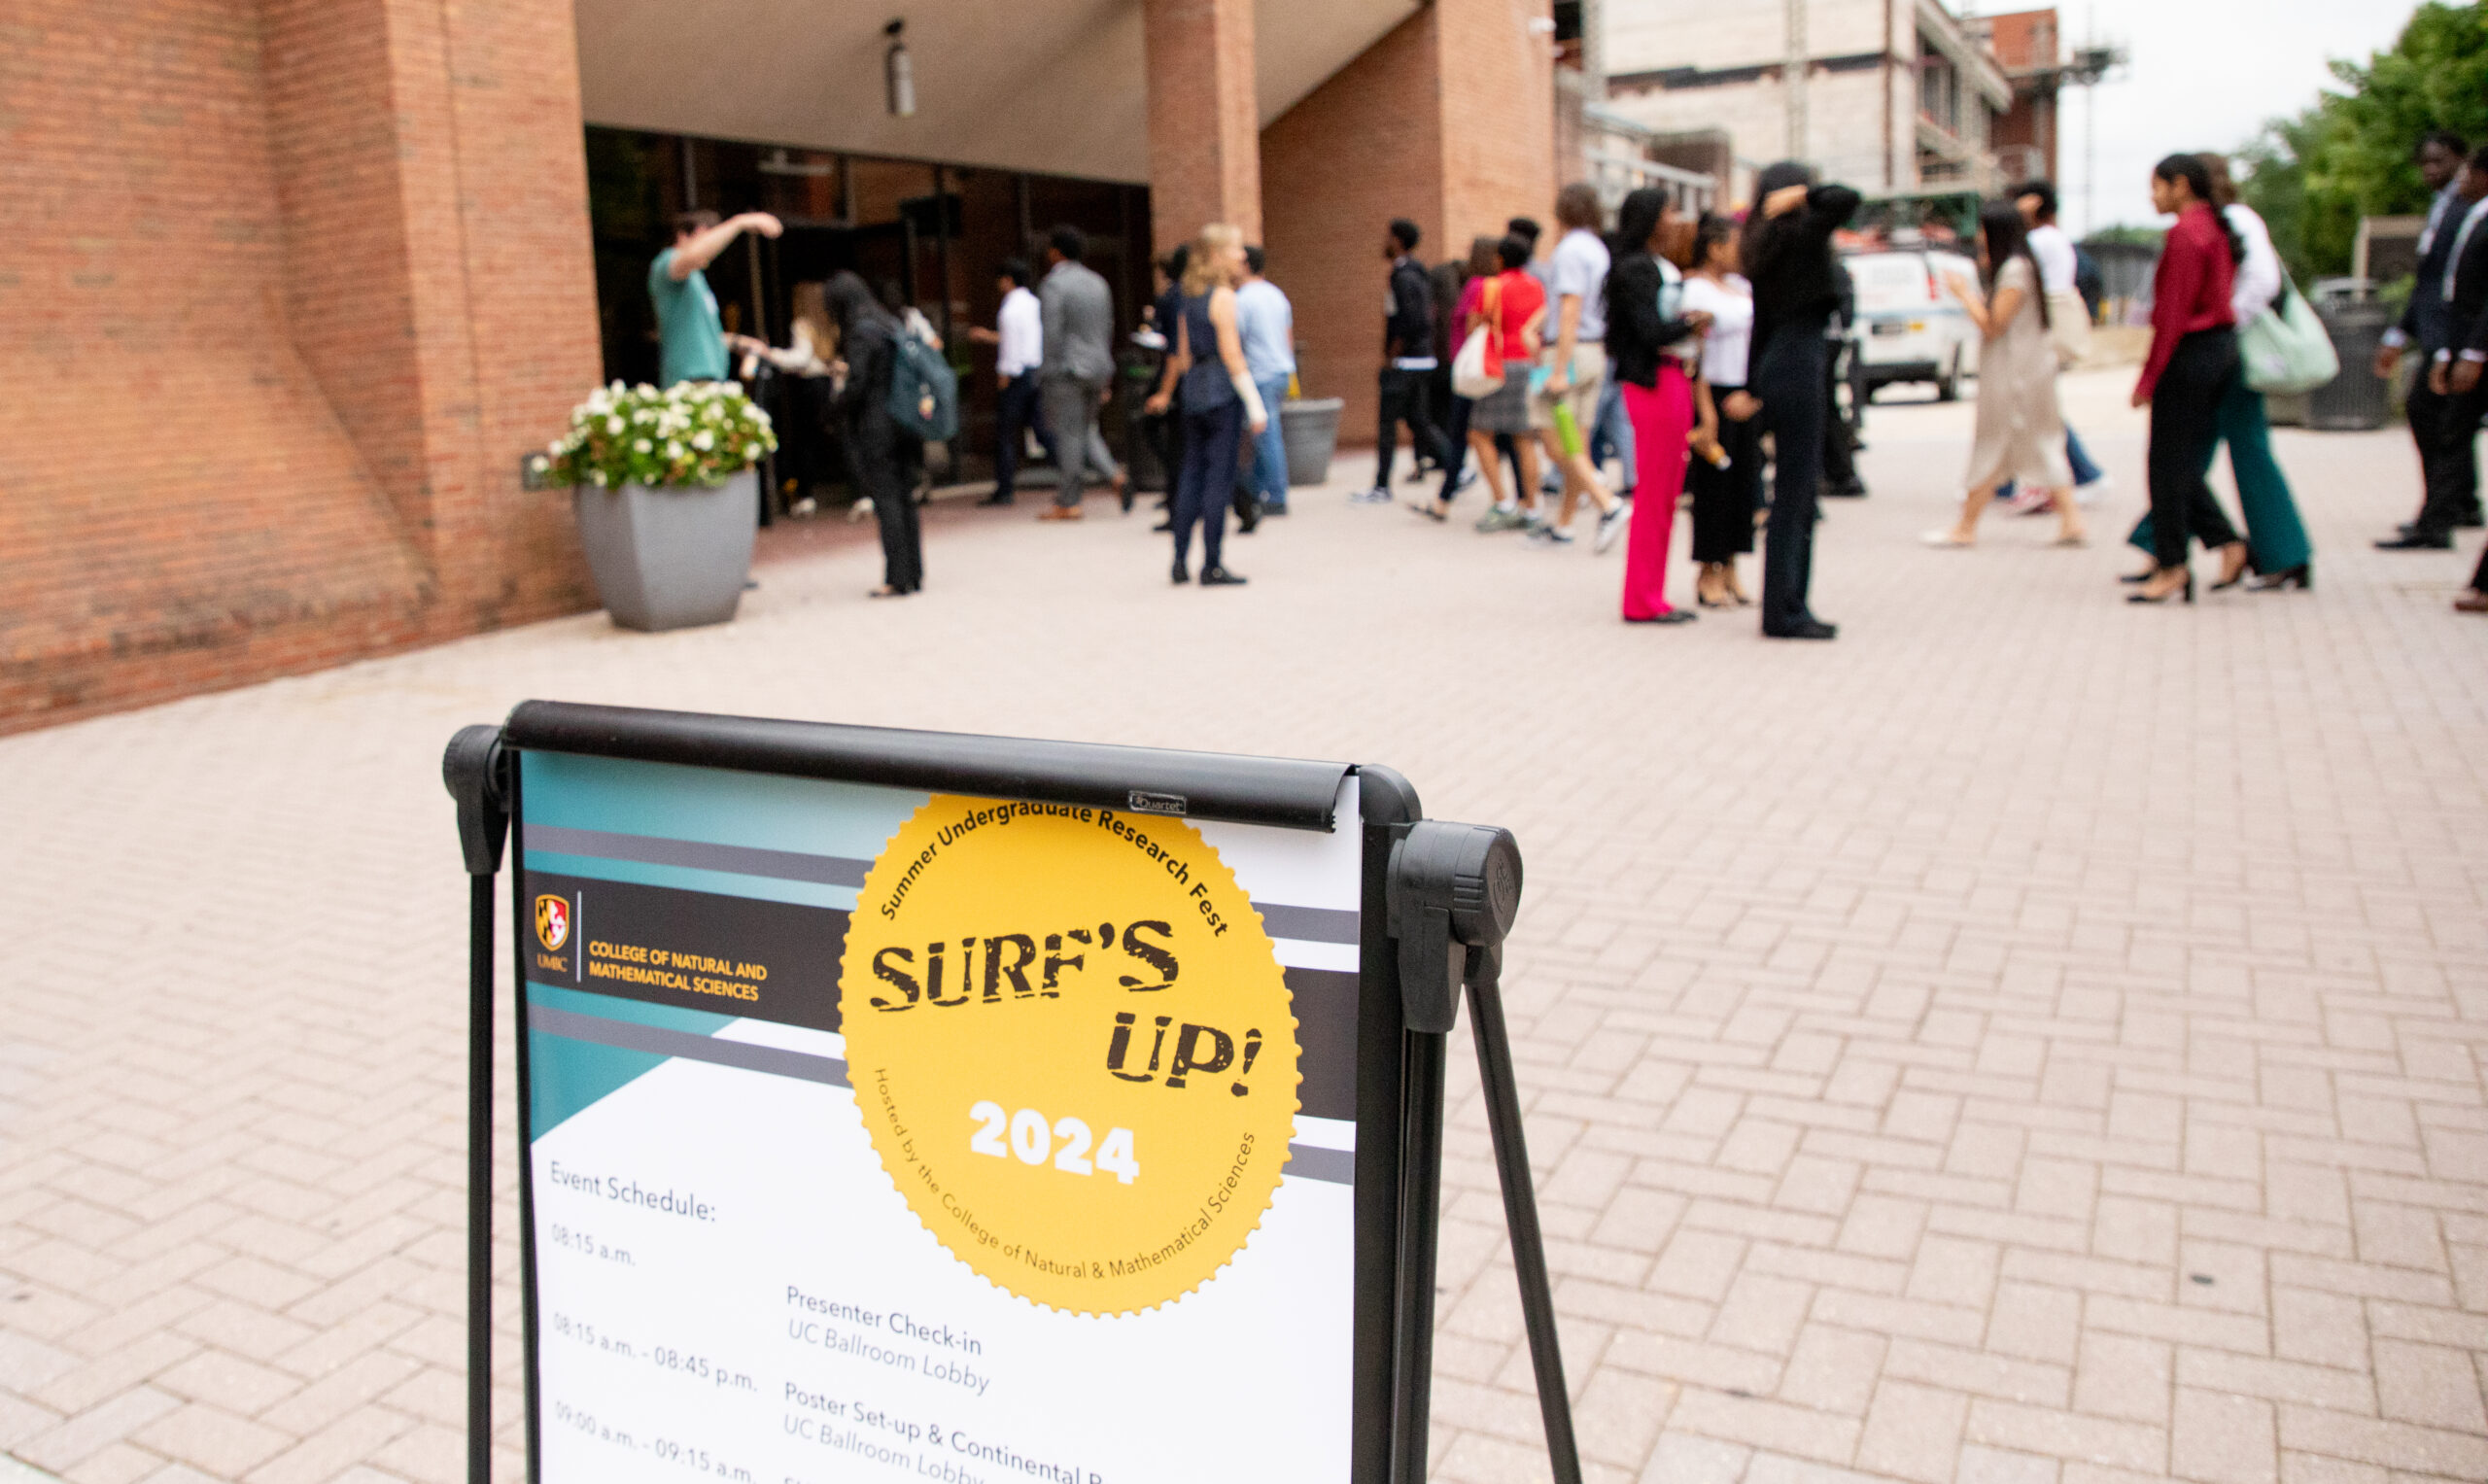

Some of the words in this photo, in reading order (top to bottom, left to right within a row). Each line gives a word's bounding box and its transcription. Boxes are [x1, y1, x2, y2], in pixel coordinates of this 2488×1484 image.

[881, 844, 939, 920] Summer
[936, 802, 1093, 847] Undergraduate
[1097, 810, 1192, 885] Research
[1189, 881, 1229, 938] Fest
[536, 953, 569, 973] UMBC
[589, 940, 648, 963] COLLEGE
[649, 948, 671, 967] OF
[672, 951, 734, 977] NATURAL
[732, 962, 768, 981] AND
[589, 960, 692, 991] MATHEMATICAL
[693, 977, 760, 1002] SCIENCES
[869, 919, 1180, 1013] SURF'S
[1106, 1012, 1262, 1097] UP!
[874, 1068, 908, 1137] Hosted
[901, 1139, 920, 1164] by
[917, 1165, 941, 1194] the
[941, 1191, 1000, 1249] College
[1003, 1242, 1022, 1260] of
[1025, 1249, 1088, 1279] Natural
[1091, 1261, 1106, 1279] &
[1110, 1208, 1213, 1278] Mathematical
[1207, 1130, 1256, 1214] Sciences
[969, 1099, 1140, 1185] 2024
[551, 1159, 602, 1196] Event
[607, 1176, 716, 1224] Schedule:
[552, 1223, 596, 1256] 08:15
[600, 1243, 637, 1266] a.m.
[554, 1311, 596, 1346] 08:15
[600, 1335, 637, 1360] a.m.
[654, 1346, 710, 1378] 08:45
[715, 1366, 758, 1392] p.m.
[786, 1284, 882, 1329] Presenter
[889, 1311, 983, 1357] Check-in
[787, 1317, 819, 1345] UC
[823, 1327, 916, 1371] Ballroom
[922, 1354, 990, 1397] Lobby
[601, 1425, 639, 1450] a.m.
[655, 1437, 710, 1472] 09:15
[783, 1412, 814, 1440] UC
[819, 1423, 911, 1470] Ballroom
[784, 1381, 847, 1417] Poster
[853, 1400, 921, 1443] Set-up
[927, 1422, 944, 1447] &
[950, 1430, 1082, 1484] Continental
